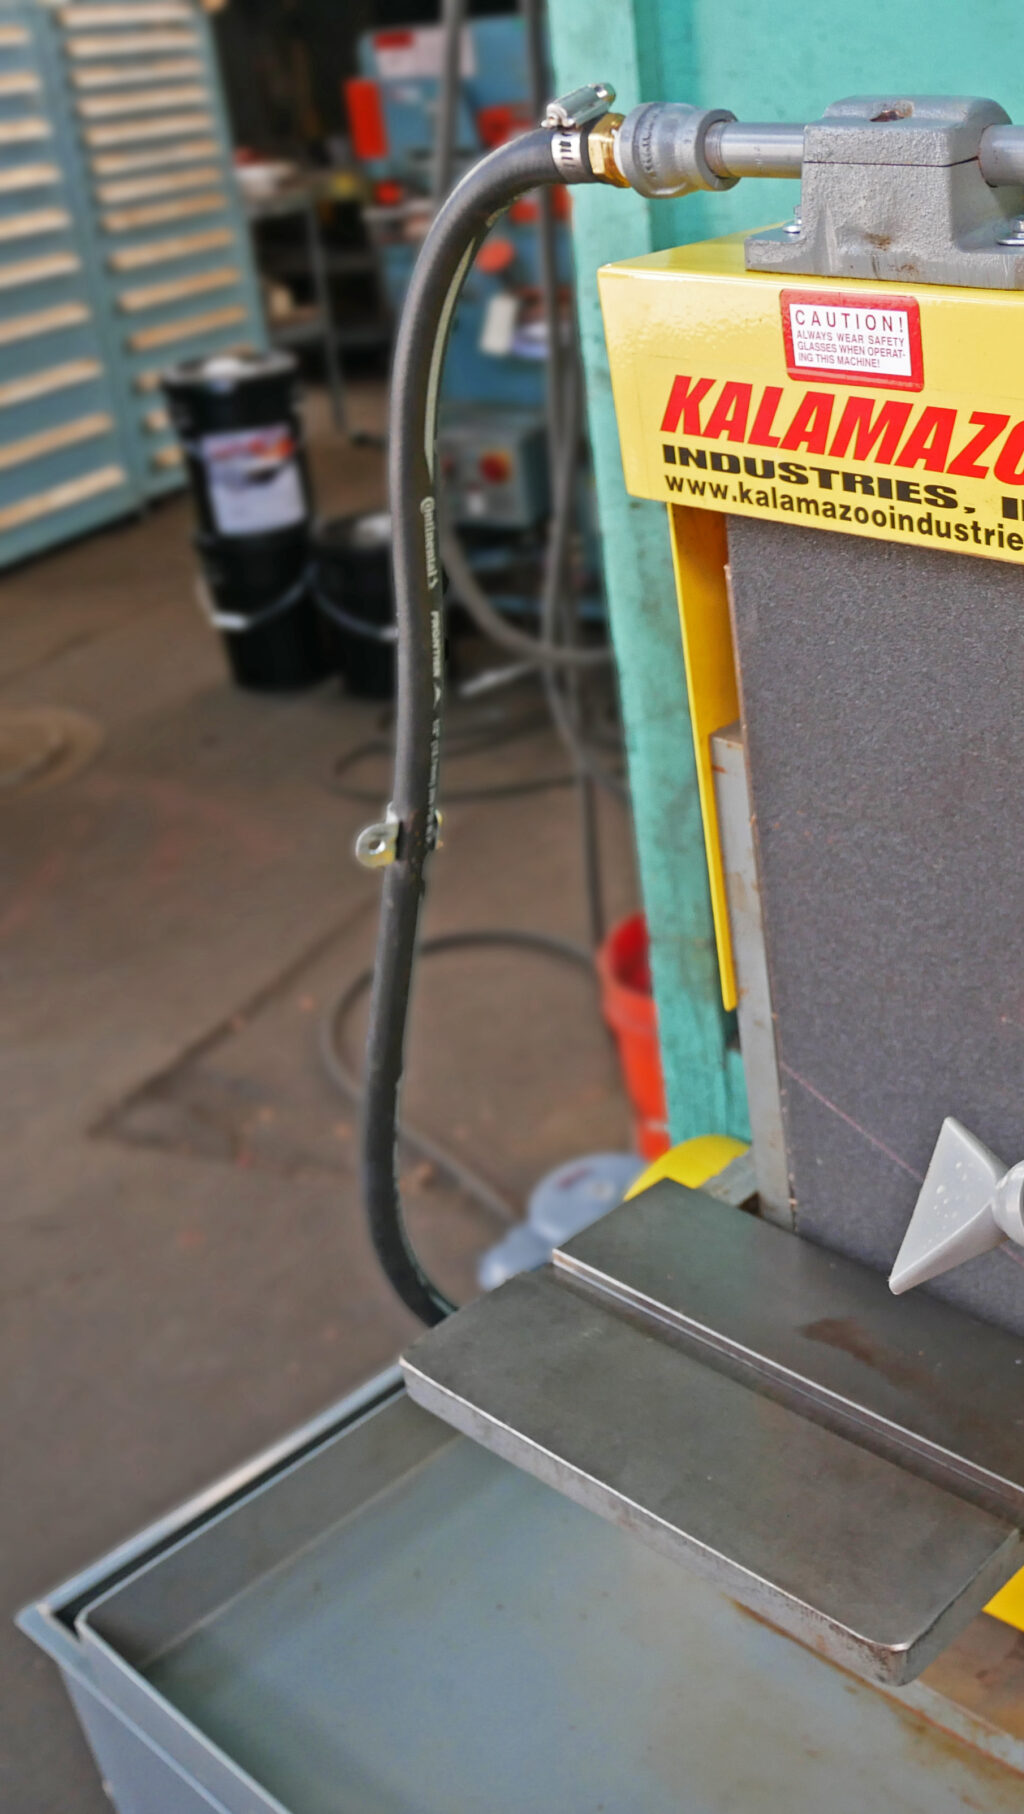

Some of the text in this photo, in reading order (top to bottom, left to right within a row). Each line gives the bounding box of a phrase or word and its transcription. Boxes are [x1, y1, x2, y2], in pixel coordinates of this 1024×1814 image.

[795, 309, 903, 333] CAUTION!
[797, 330, 904, 347] ALWAYS WEAR SAFETY
[797, 341, 906, 359] GLASSES WHEN OPERAT-
[798, 353, 881, 368] ING THIS MACHINE!
[662, 445, 975, 515] INDUSTRIES,
